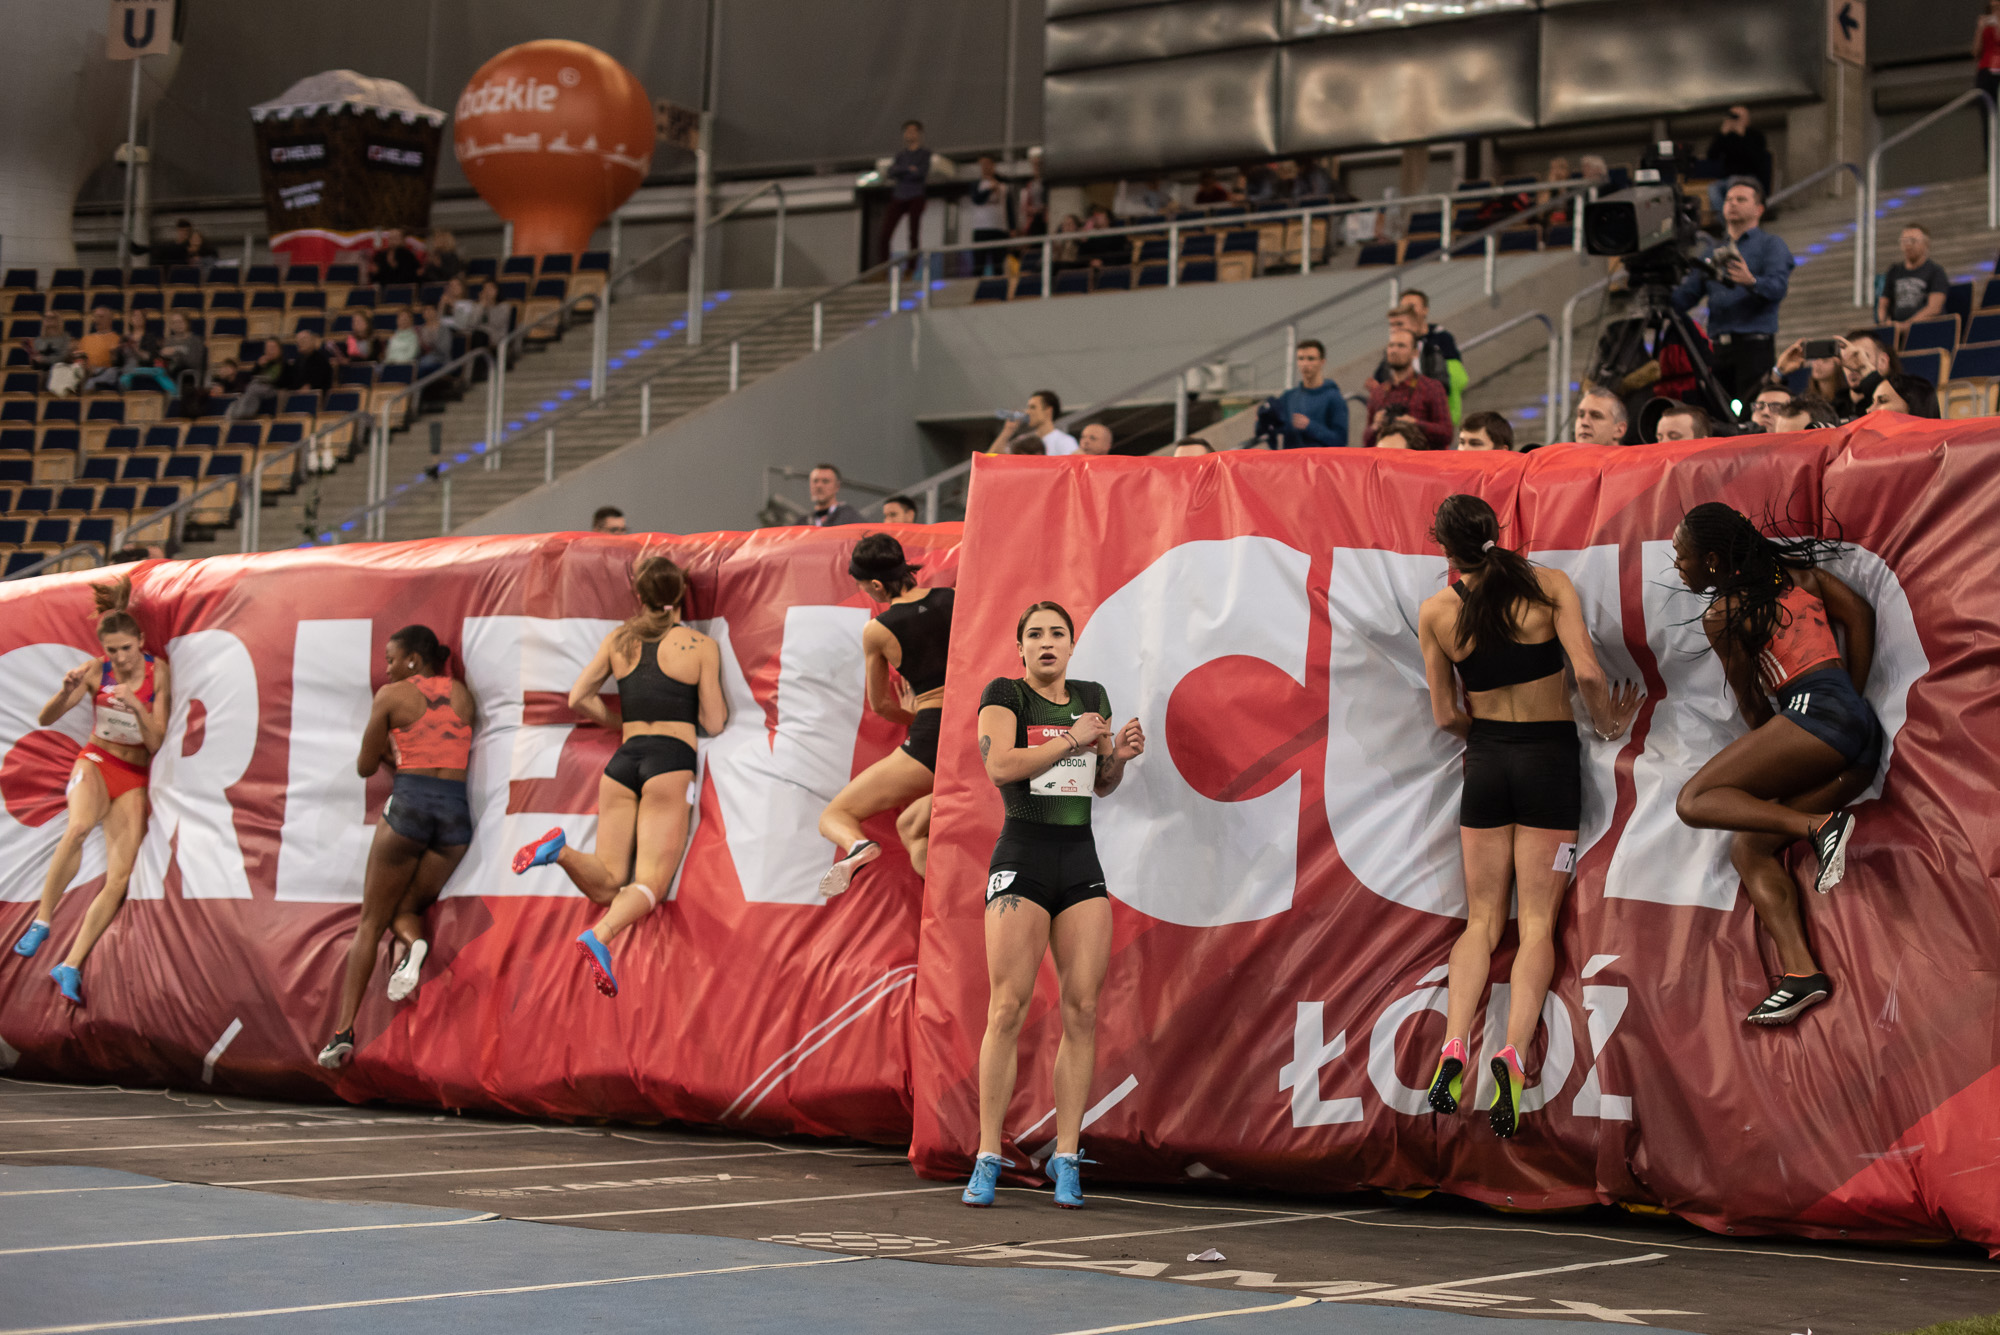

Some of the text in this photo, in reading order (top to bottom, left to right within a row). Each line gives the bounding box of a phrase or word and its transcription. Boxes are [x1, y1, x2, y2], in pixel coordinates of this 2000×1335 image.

[124, 8, 156, 49] U
[1052, 758, 1087, 768] WOBODA
[1279, 953, 1633, 1128] ŁÓDŹ
